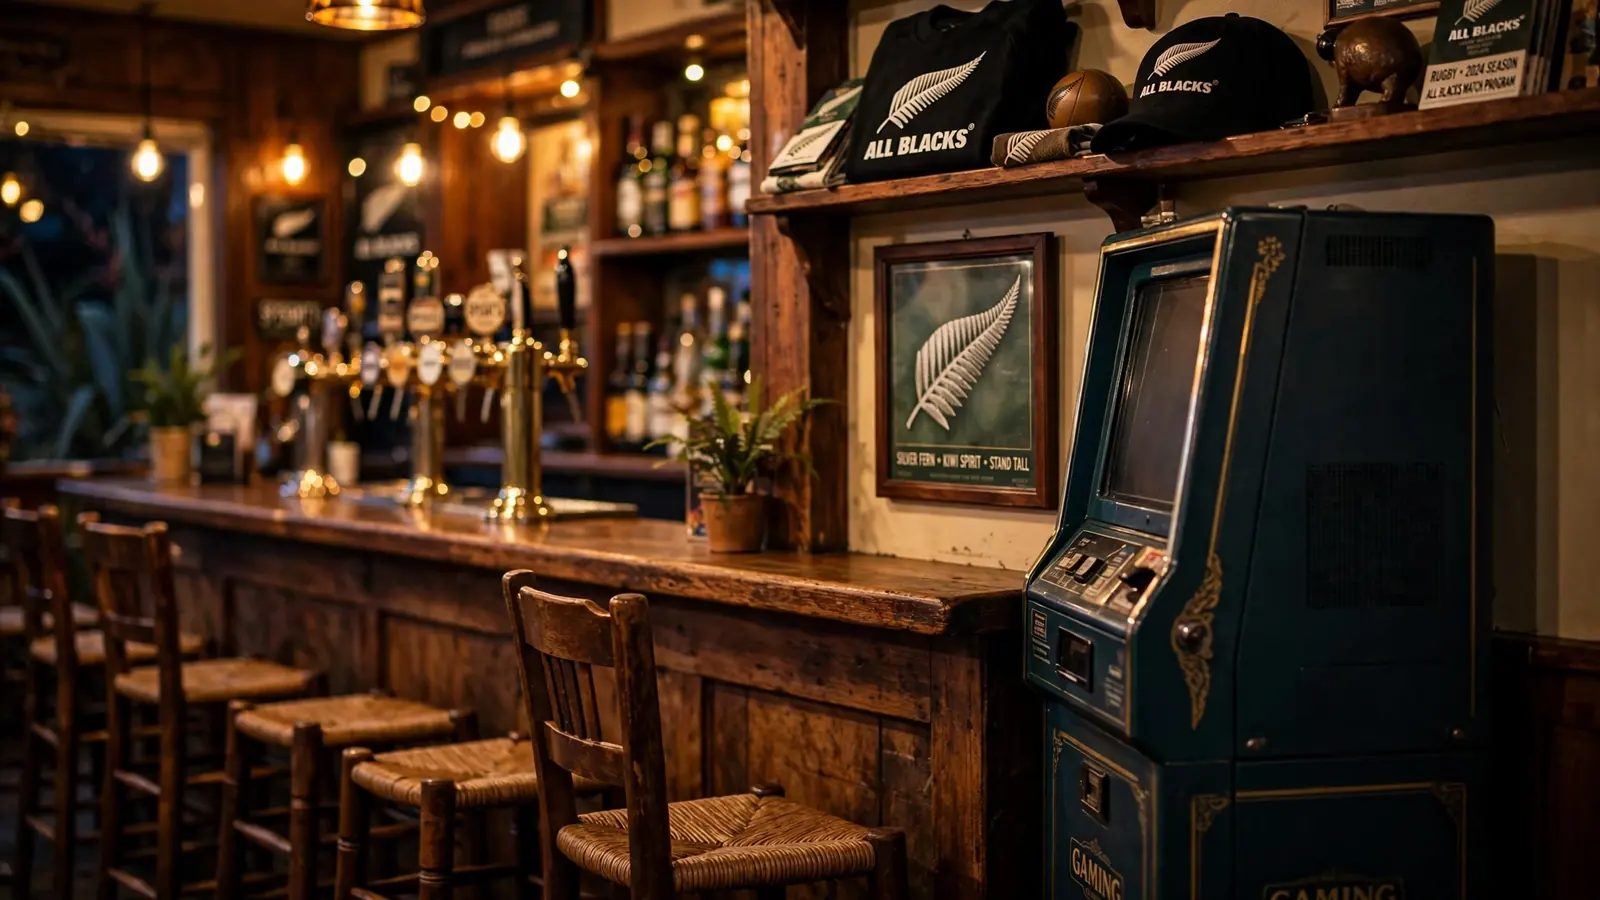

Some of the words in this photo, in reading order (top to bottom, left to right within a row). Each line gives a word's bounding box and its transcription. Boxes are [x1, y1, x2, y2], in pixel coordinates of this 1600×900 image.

[1448, 28, 1470, 41] ALL
[1430, 67, 1458, 83] RUGBY
[1465, 64, 1485, 78] 2024
[1486, 57, 1518, 74] SEASON
[1140, 83, 1156, 98] ALL
[863, 139, 893, 160] ALL
[896, 452, 918, 466] SILVER
[919, 453, 936, 467] FERN
[942, 454, 959, 468] KIWI
[960, 454, 981, 469] SPIRIT
[989, 456, 1012, 471] STAND
[1013, 457, 1030, 471] TALL
[1072, 847, 1121, 900] GAMING
